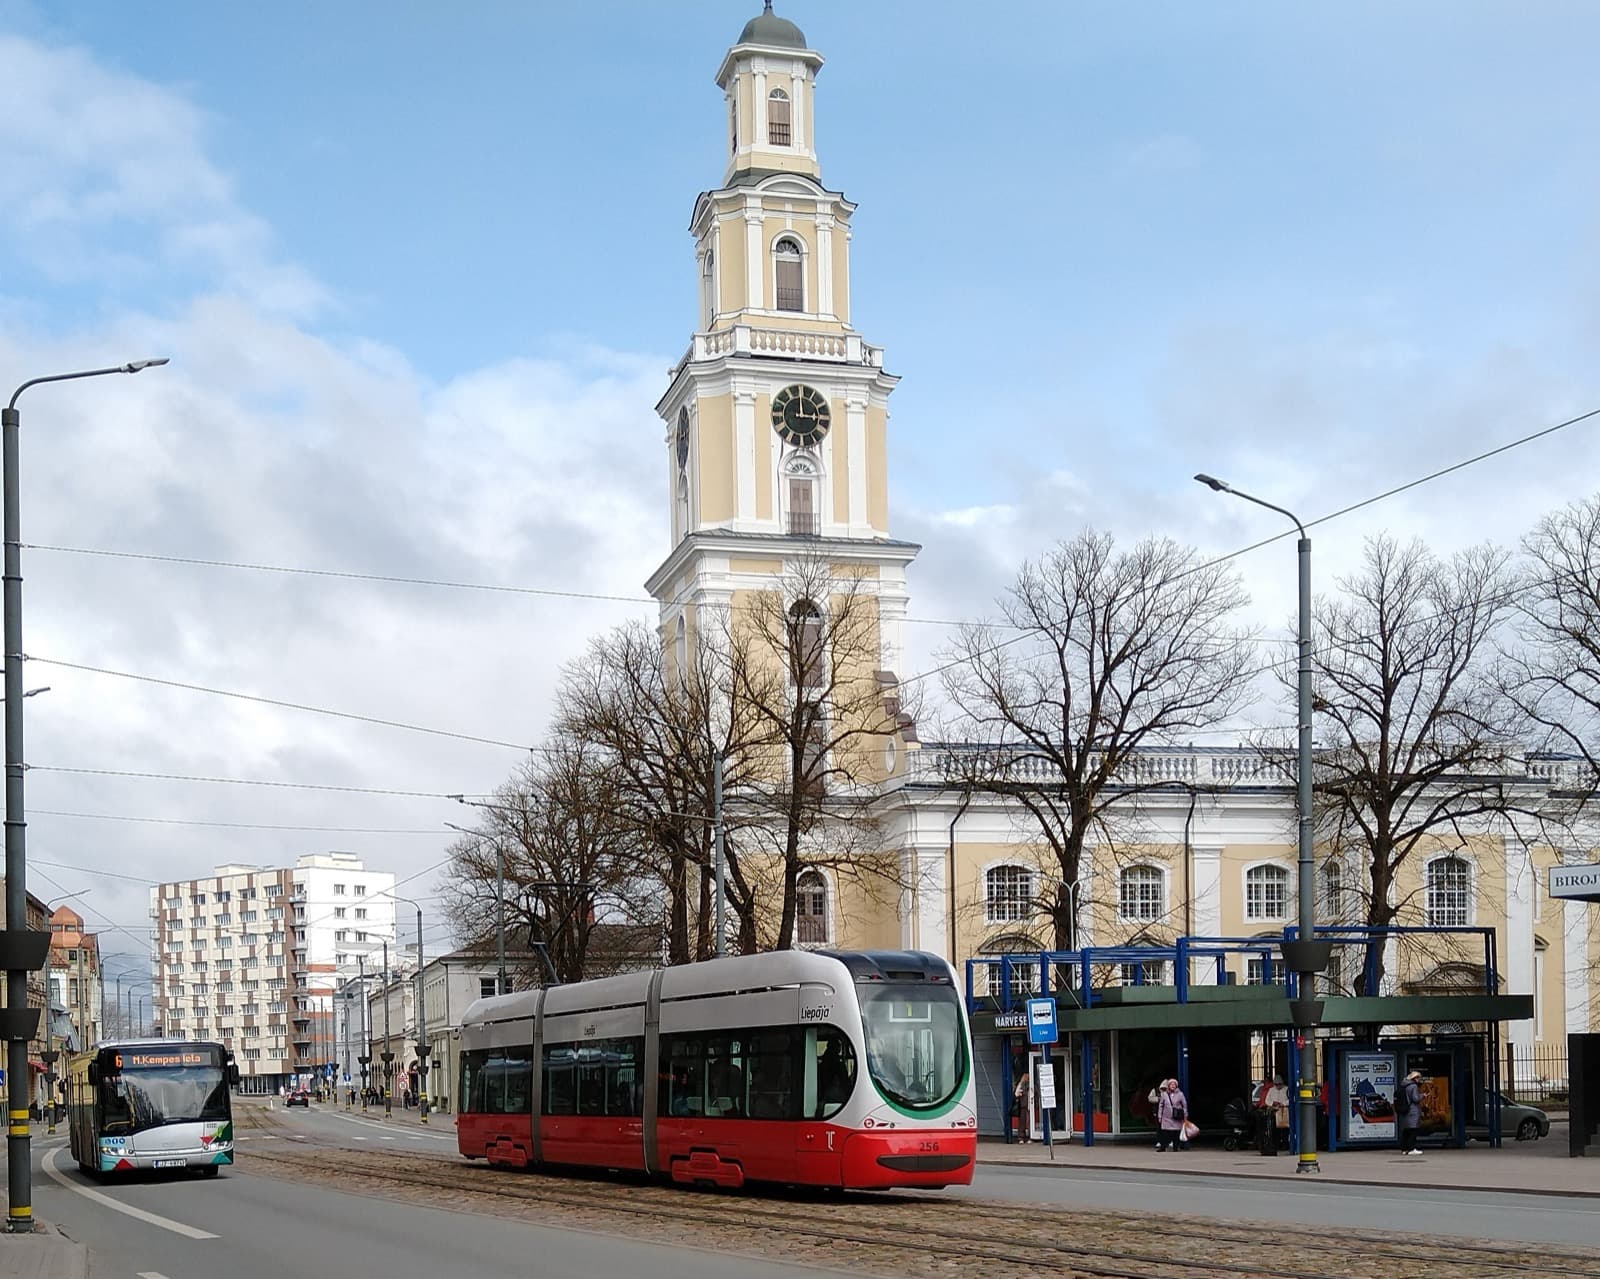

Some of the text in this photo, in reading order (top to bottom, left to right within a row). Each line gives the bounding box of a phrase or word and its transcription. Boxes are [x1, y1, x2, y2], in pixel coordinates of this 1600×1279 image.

[1555, 874, 1600, 887] BIROJ
[801, 1005, 829, 1021] Liepāja
[995, 1015, 1027, 1028] NARVESE
[115, 1055, 123, 1068] 6
[919, 1142, 940, 1152] 256
